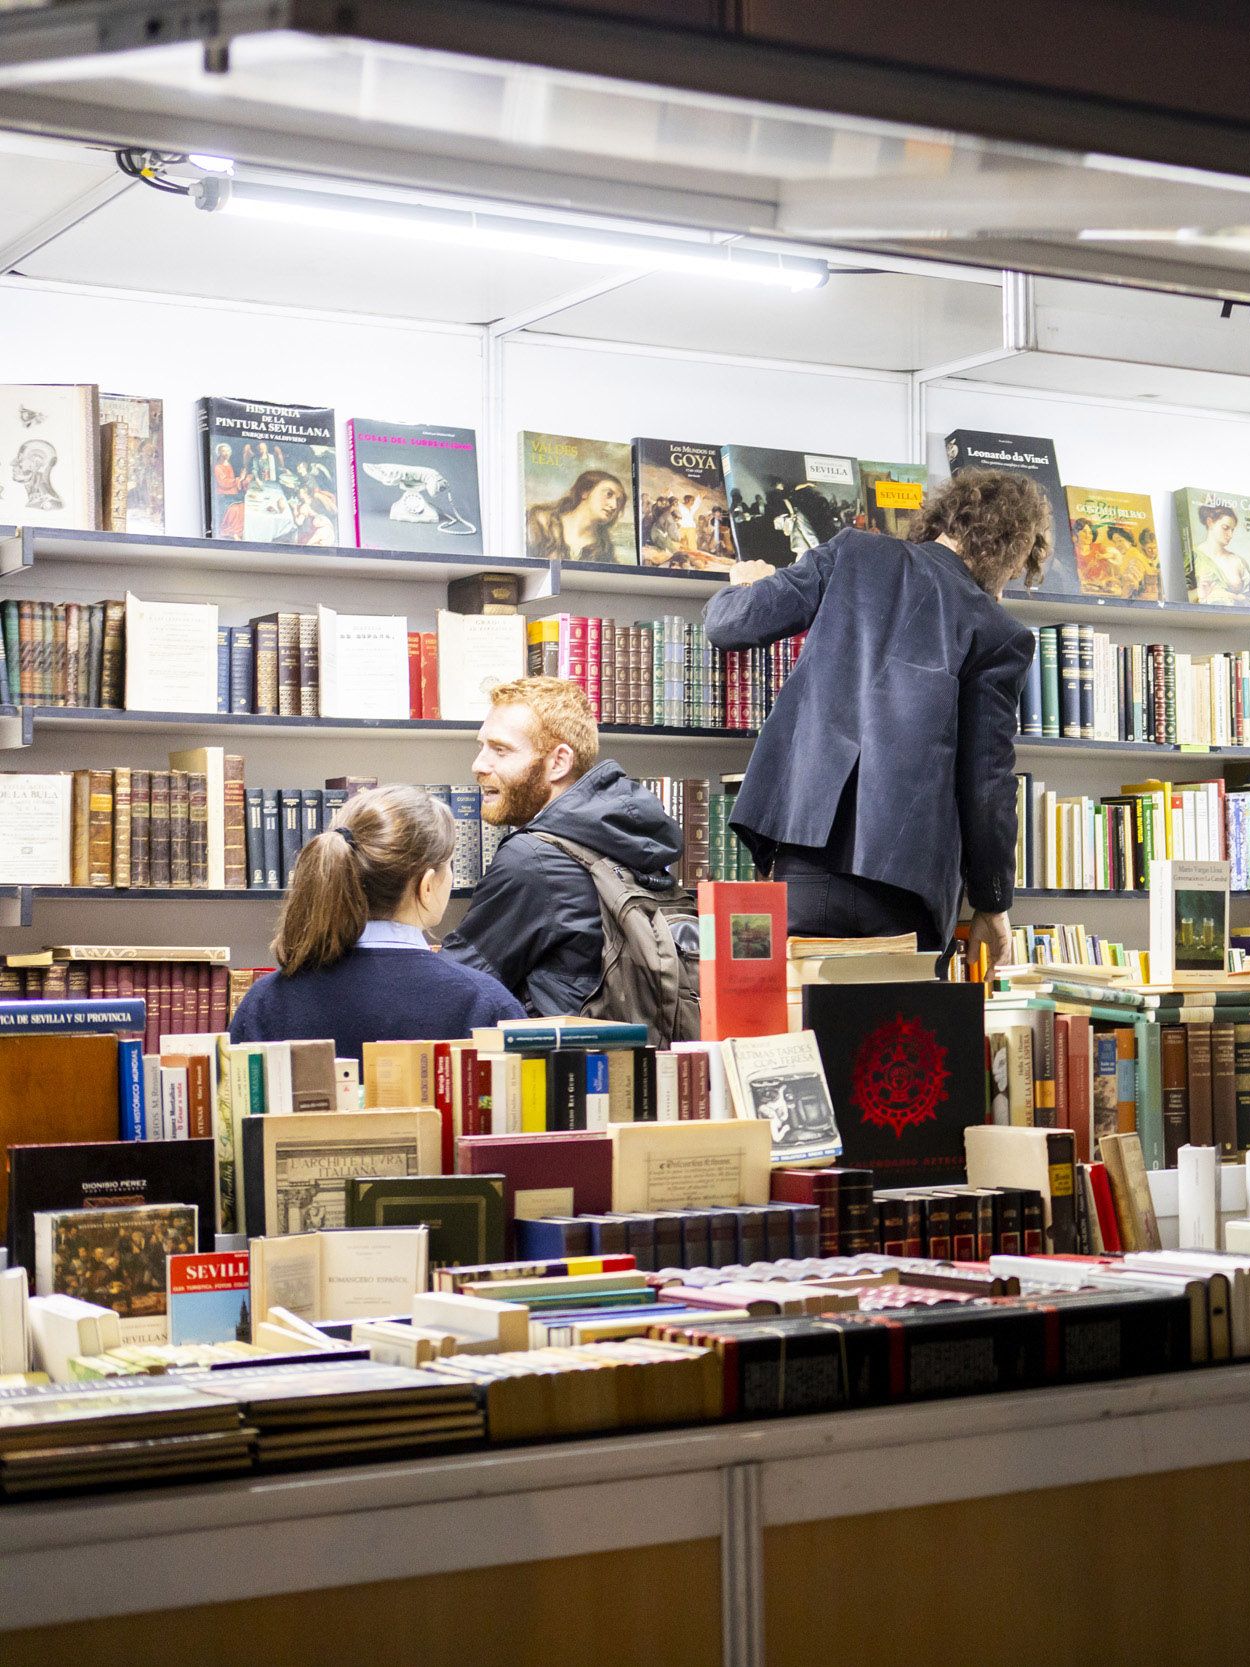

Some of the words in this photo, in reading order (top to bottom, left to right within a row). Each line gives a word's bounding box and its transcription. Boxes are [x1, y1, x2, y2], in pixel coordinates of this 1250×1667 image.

[245, 403, 301, 418] HISTORIA
[261, 414, 273, 423] DE
[273, 416, 285, 425] LA
[215, 417, 267, 431] PINTURA
[267, 423, 330, 438] SEVILLANA
[390, 436, 407, 446] DEL
[670, 452, 717, 470] GOYA
[967, 447, 1012, 461] Leonardo
[1012, 451, 1024, 462] da
[1023, 453, 1049, 465] Vinci
[810, 465, 848, 476] SEVILLA
[880, 491, 918, 501] SEVILLA
[1205, 492, 1238, 508] Alonso
[0, 1014, 15, 1025] ICA
[17, 1014, 28, 1025] DE
[31, 1013, 65, 1024] SEVILLA
[66, 1013, 73, 1023] Y
[74, 1013, 85, 1023] SU
[87, 1012, 132, 1023] PROVINCIA
[777, 1044, 813, 1054] TARDES
[1023, 1034, 1031, 1060] ESPERA
[131, 1049, 139, 1082] MUNDIAL
[779, 1053, 815, 1065] TERESA
[1024, 1064, 1032, 1085] LARGA
[133, 1084, 141, 1123] HISTÓRICO
[197, 1106, 205, 1135] ATENAS
[319, 1166, 378, 1178] ITALIANA
[81, 1181, 119, 1190] DIONISIO
[185, 1261, 249, 1280] SEVILL
